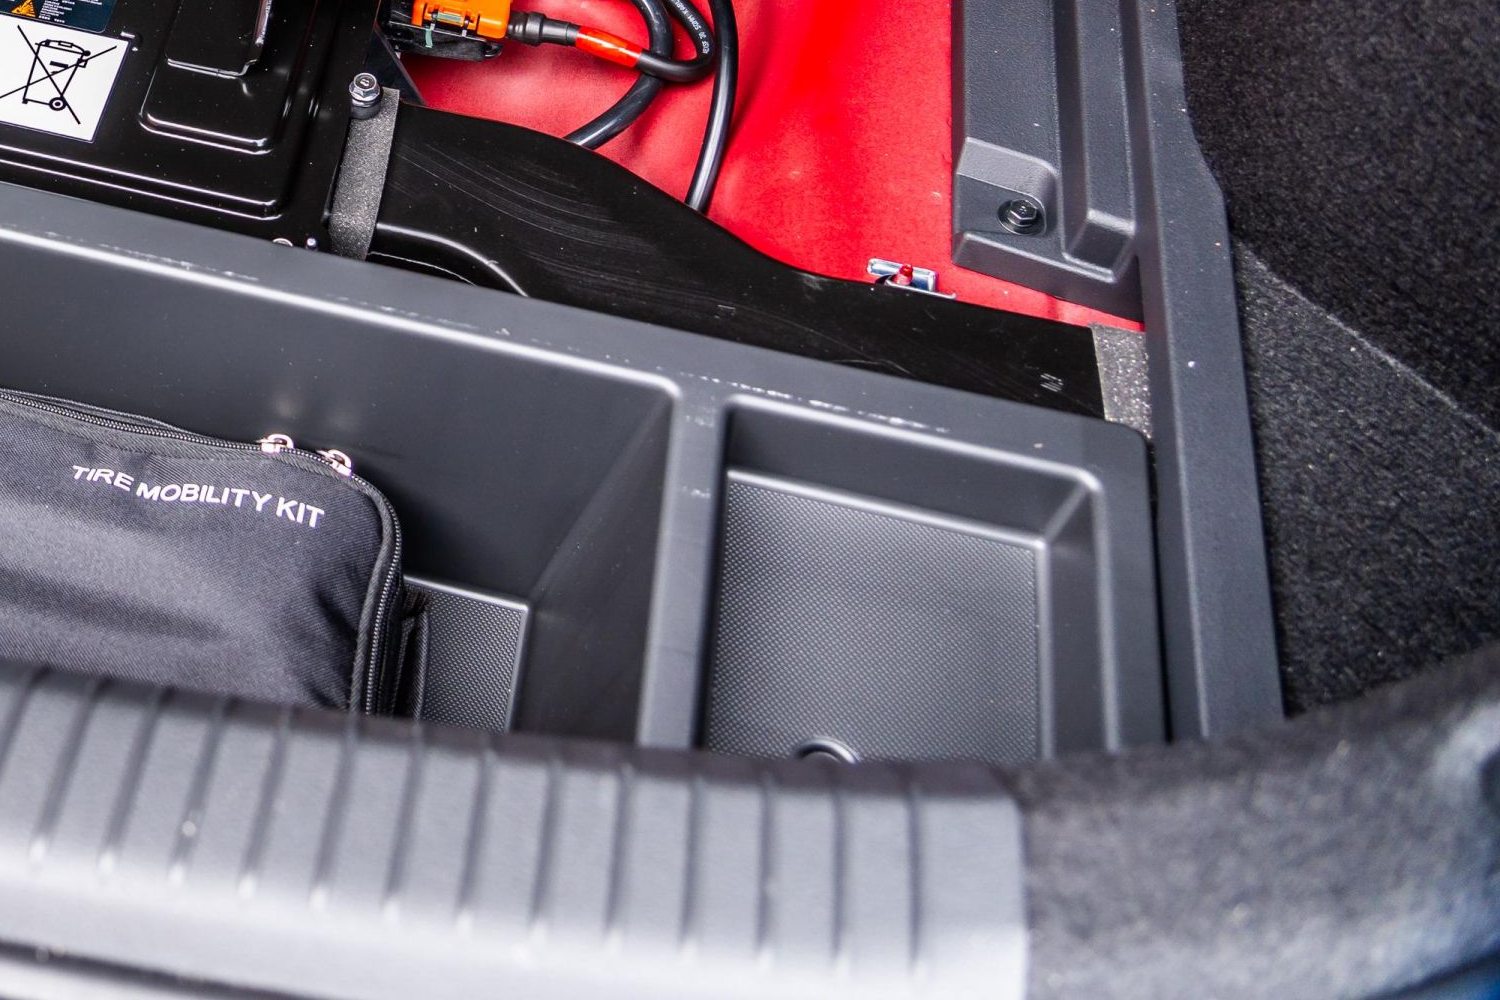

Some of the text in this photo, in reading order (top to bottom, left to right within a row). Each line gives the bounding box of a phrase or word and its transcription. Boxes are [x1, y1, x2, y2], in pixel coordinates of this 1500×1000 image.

[72, 465, 325, 528] TIRE MOBILITY KIT
